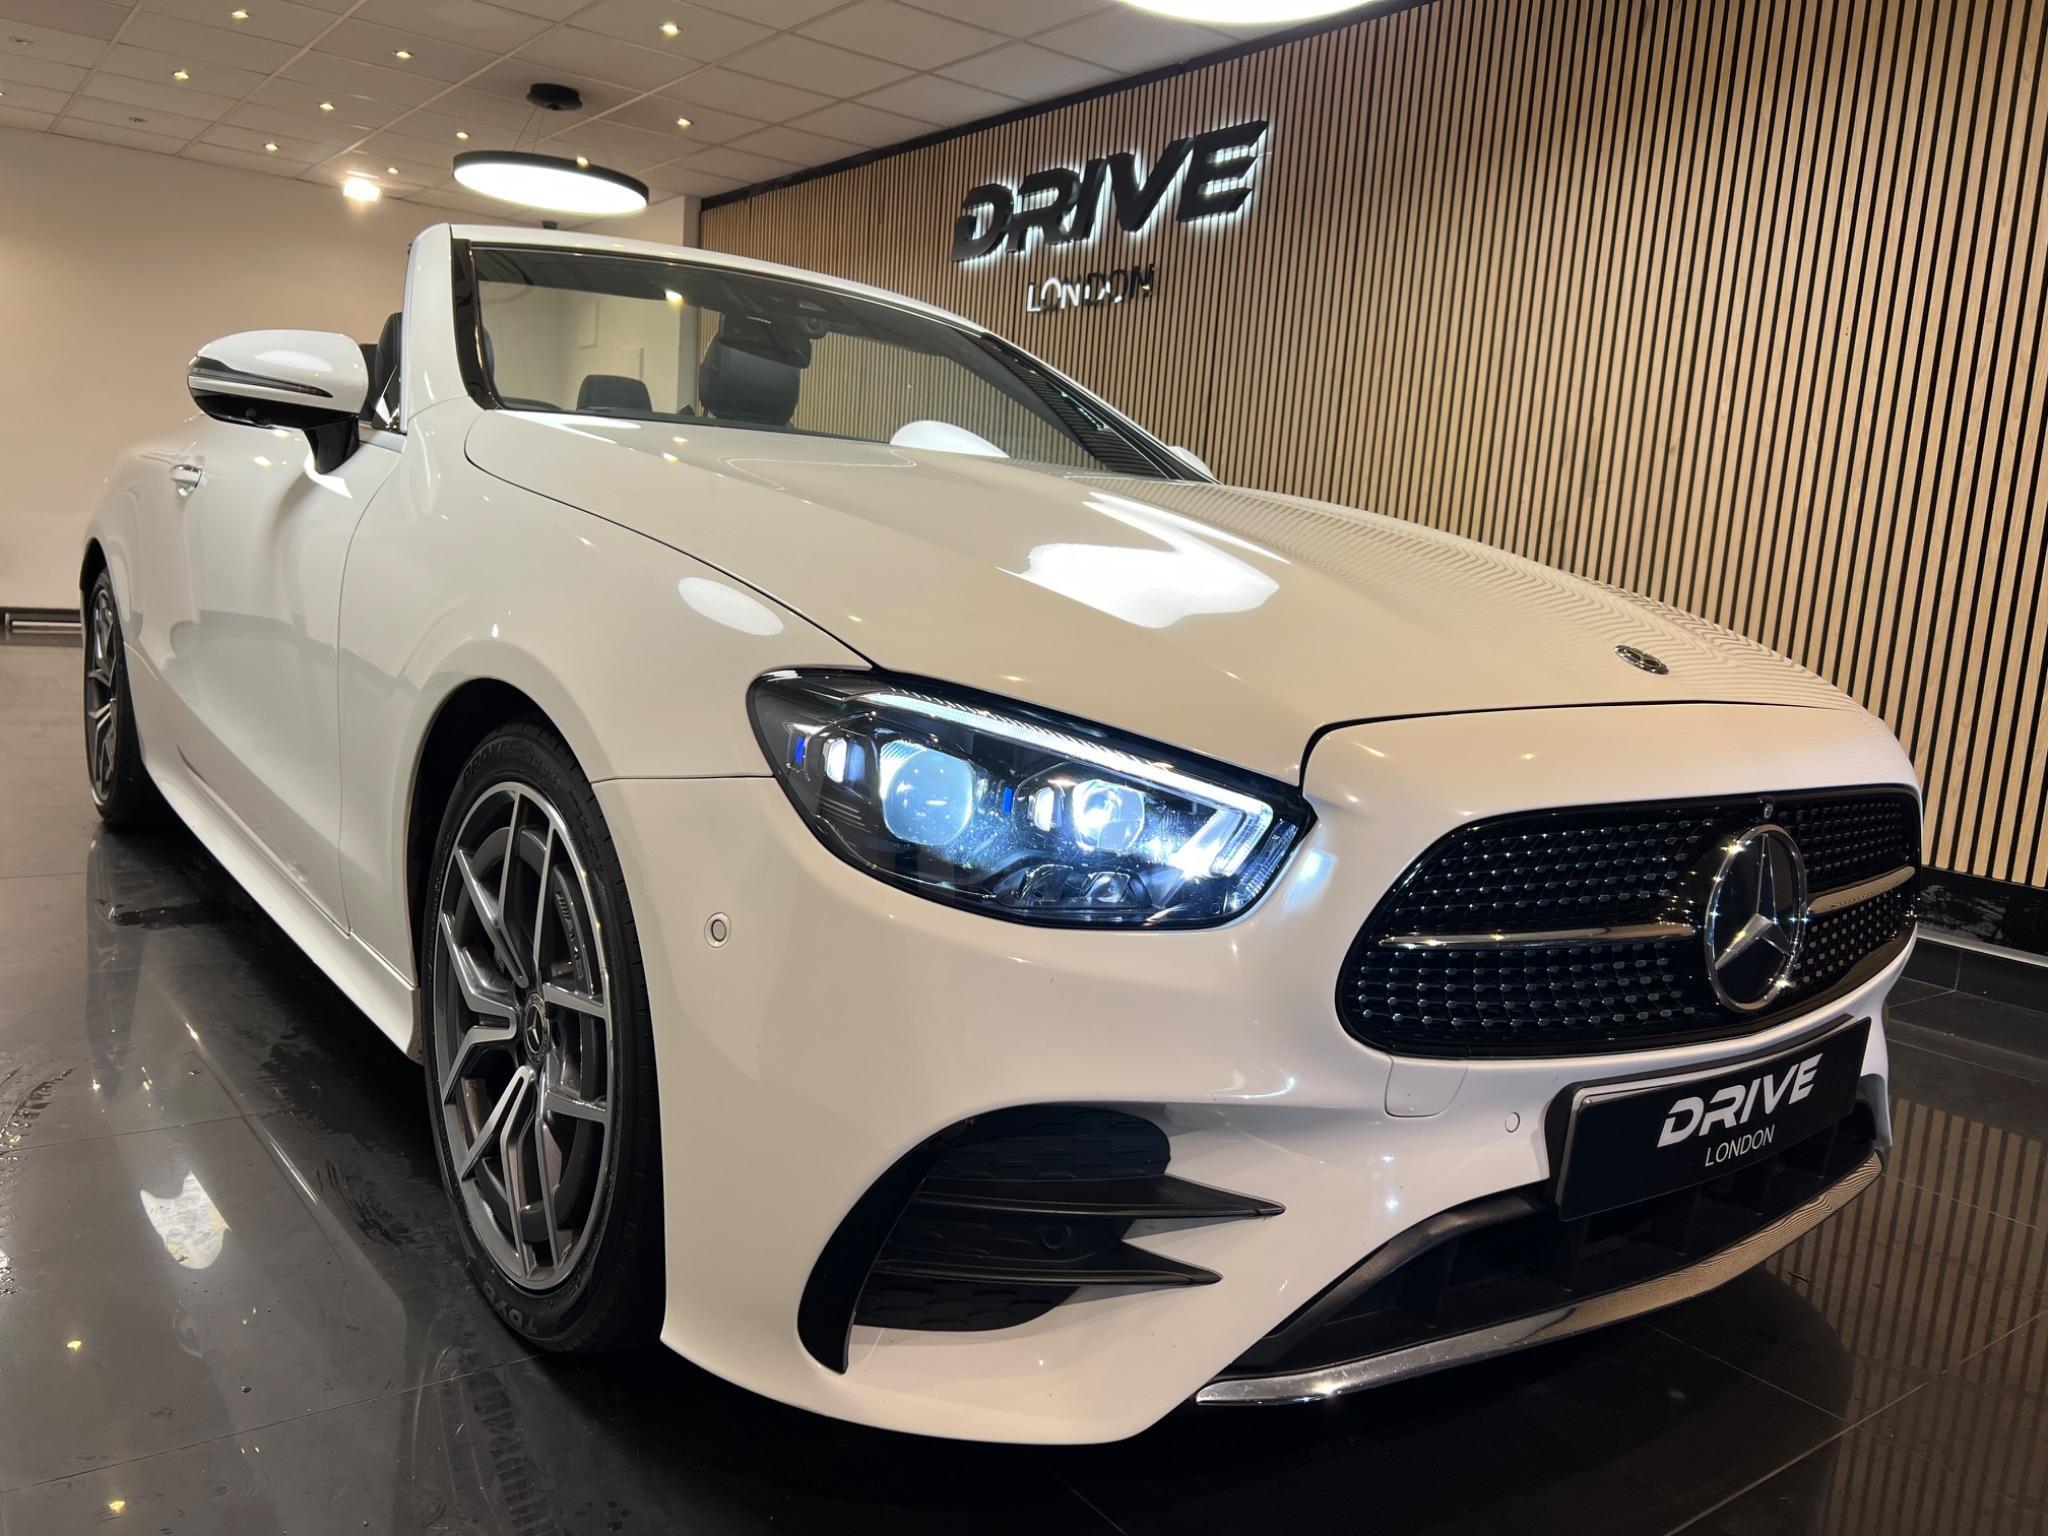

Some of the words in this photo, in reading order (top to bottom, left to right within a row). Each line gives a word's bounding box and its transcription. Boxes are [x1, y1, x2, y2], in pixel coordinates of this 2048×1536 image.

[951, 120, 1268, 263] DRIVE
[1026, 263, 1155, 313] LONDON
[1657, 1053, 1823, 1148] DRIVE
[1705, 1124, 1775, 1167] LONDON
